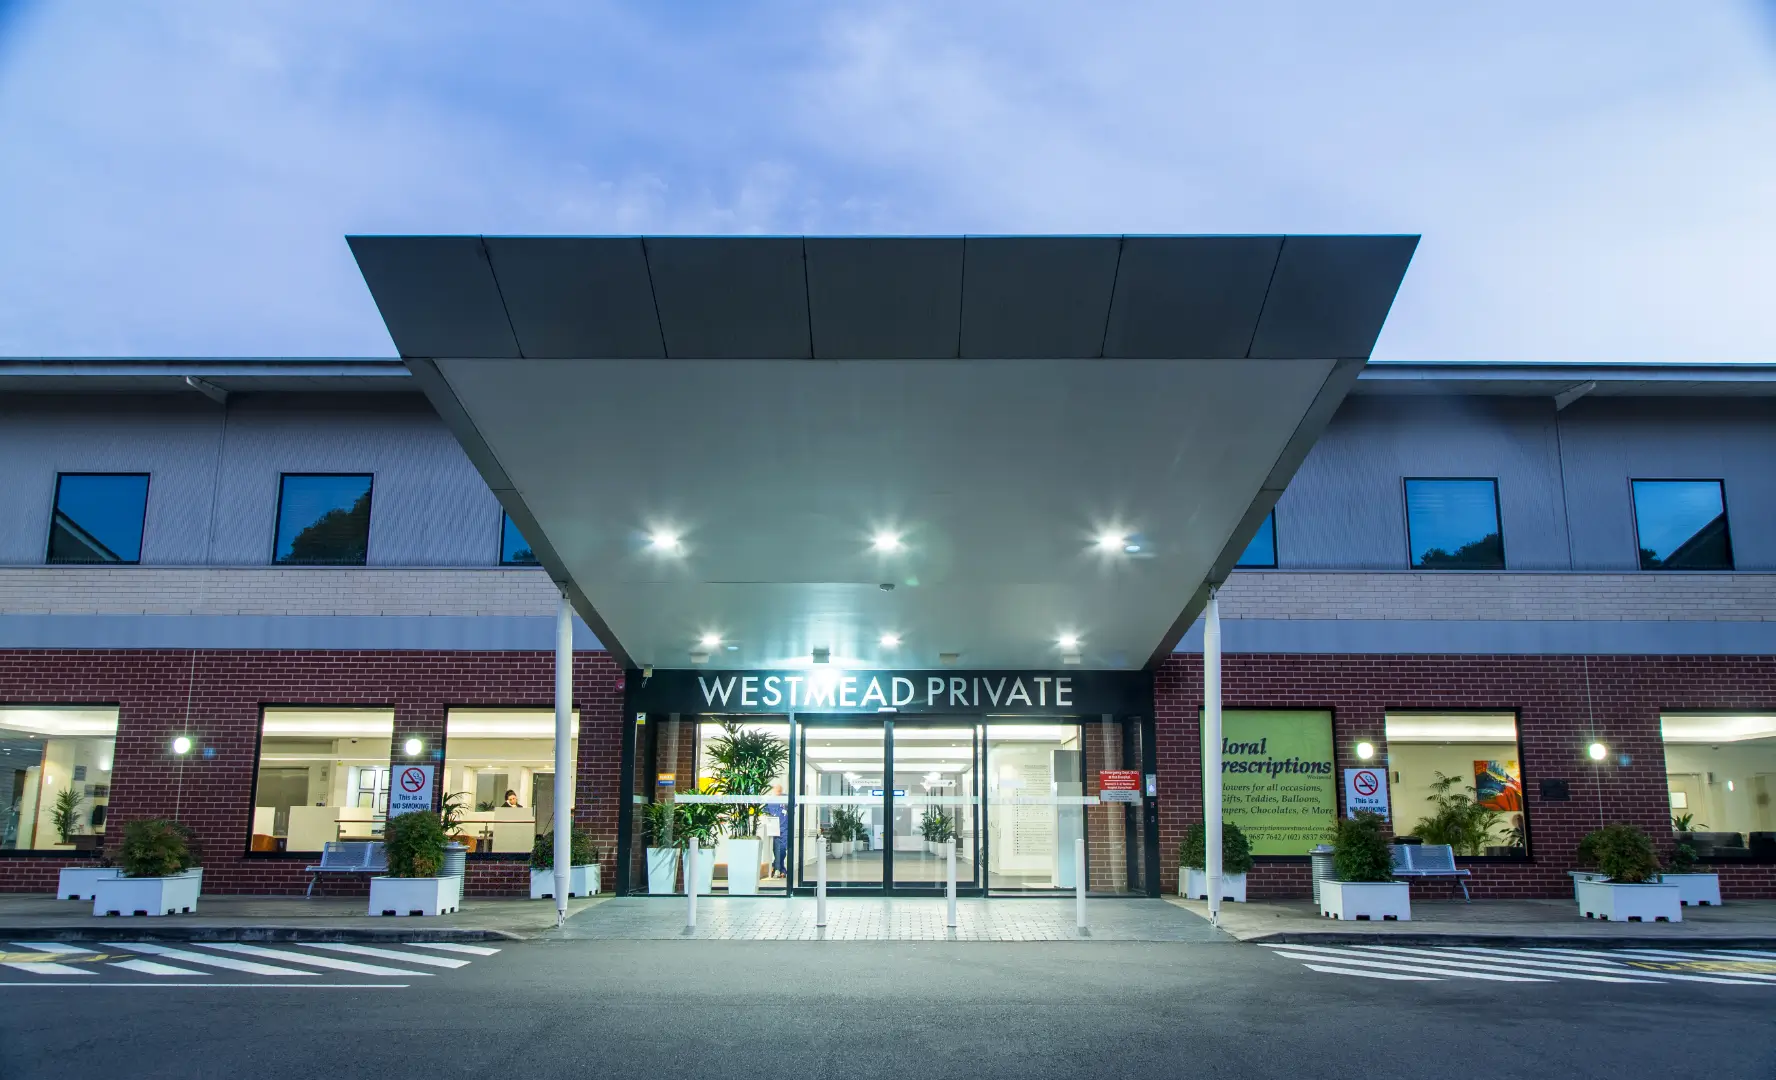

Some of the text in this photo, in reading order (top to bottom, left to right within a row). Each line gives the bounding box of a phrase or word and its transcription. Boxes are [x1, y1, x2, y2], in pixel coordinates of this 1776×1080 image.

[697, 675, 1073, 708] WESTMEAD PRIVATE
[1221, 737, 1267, 755] loral
[1221, 757, 1332, 779] rescriptions
[1222, 783, 1323, 793] lowers for all occasions,
[1245, 794, 1279, 804] Teddies,
[1281, 794, 1321, 804] Balloons,
[1250, 805, 1299, 815] Chocolates,
[1301, 806, 1309, 814] &
